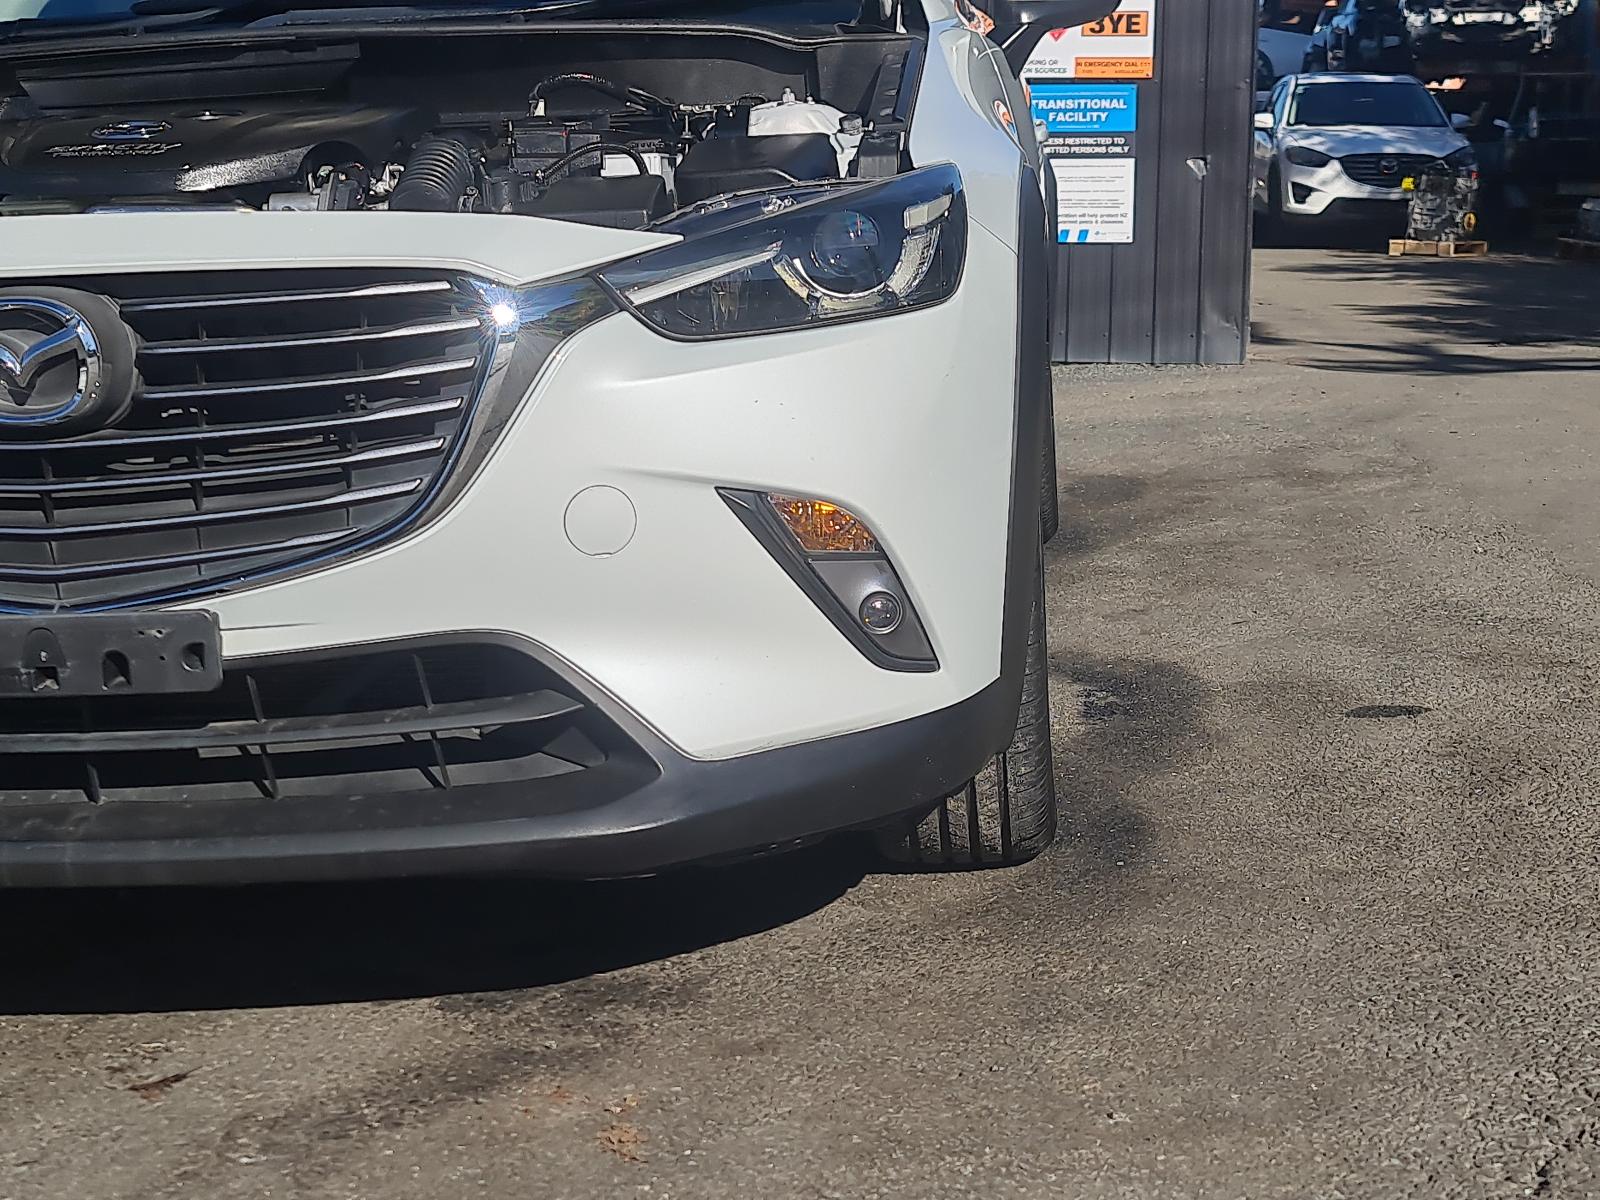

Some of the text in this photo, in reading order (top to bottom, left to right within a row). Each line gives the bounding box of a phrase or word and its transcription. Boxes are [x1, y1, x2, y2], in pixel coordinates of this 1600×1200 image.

[1032, 99, 1128, 109] TRANSITIONAL
[1048, 111, 1109, 122] FACILITY
[1065, 137, 1112, 145] RESTRICTED
[1113, 137, 1126, 145] TO
